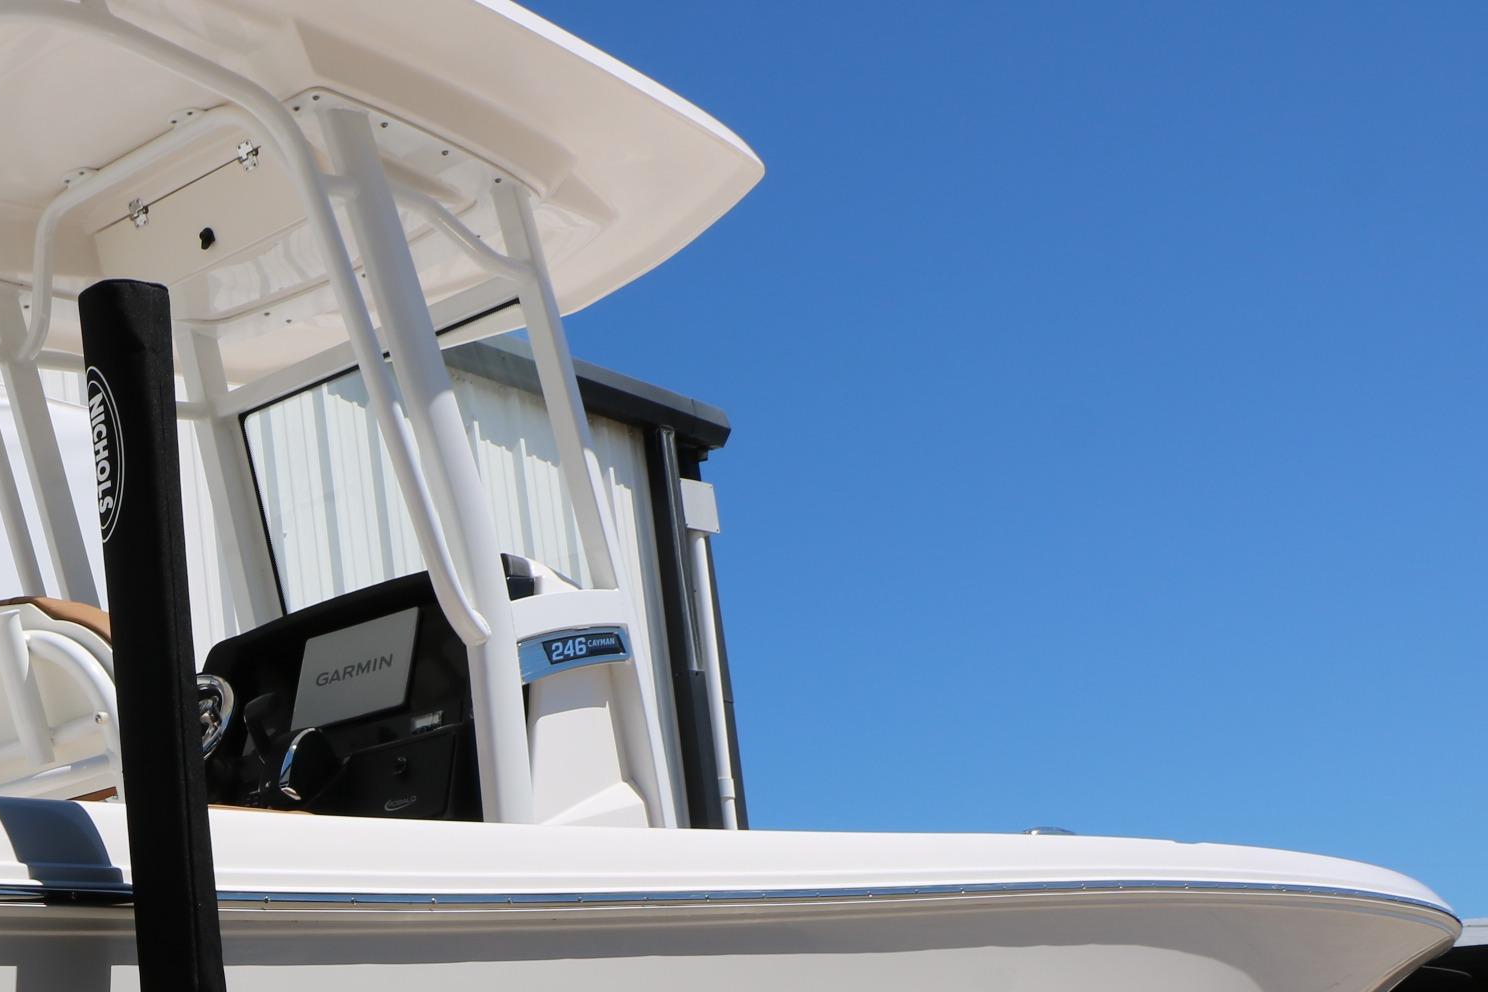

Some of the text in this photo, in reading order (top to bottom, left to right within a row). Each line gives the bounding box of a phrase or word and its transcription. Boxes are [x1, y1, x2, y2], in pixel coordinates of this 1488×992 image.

[89, 391, 114, 514] NICHOLS
[552, 637, 616, 661] 246 CAYMAN
[315, 653, 394, 687] GARMIN
